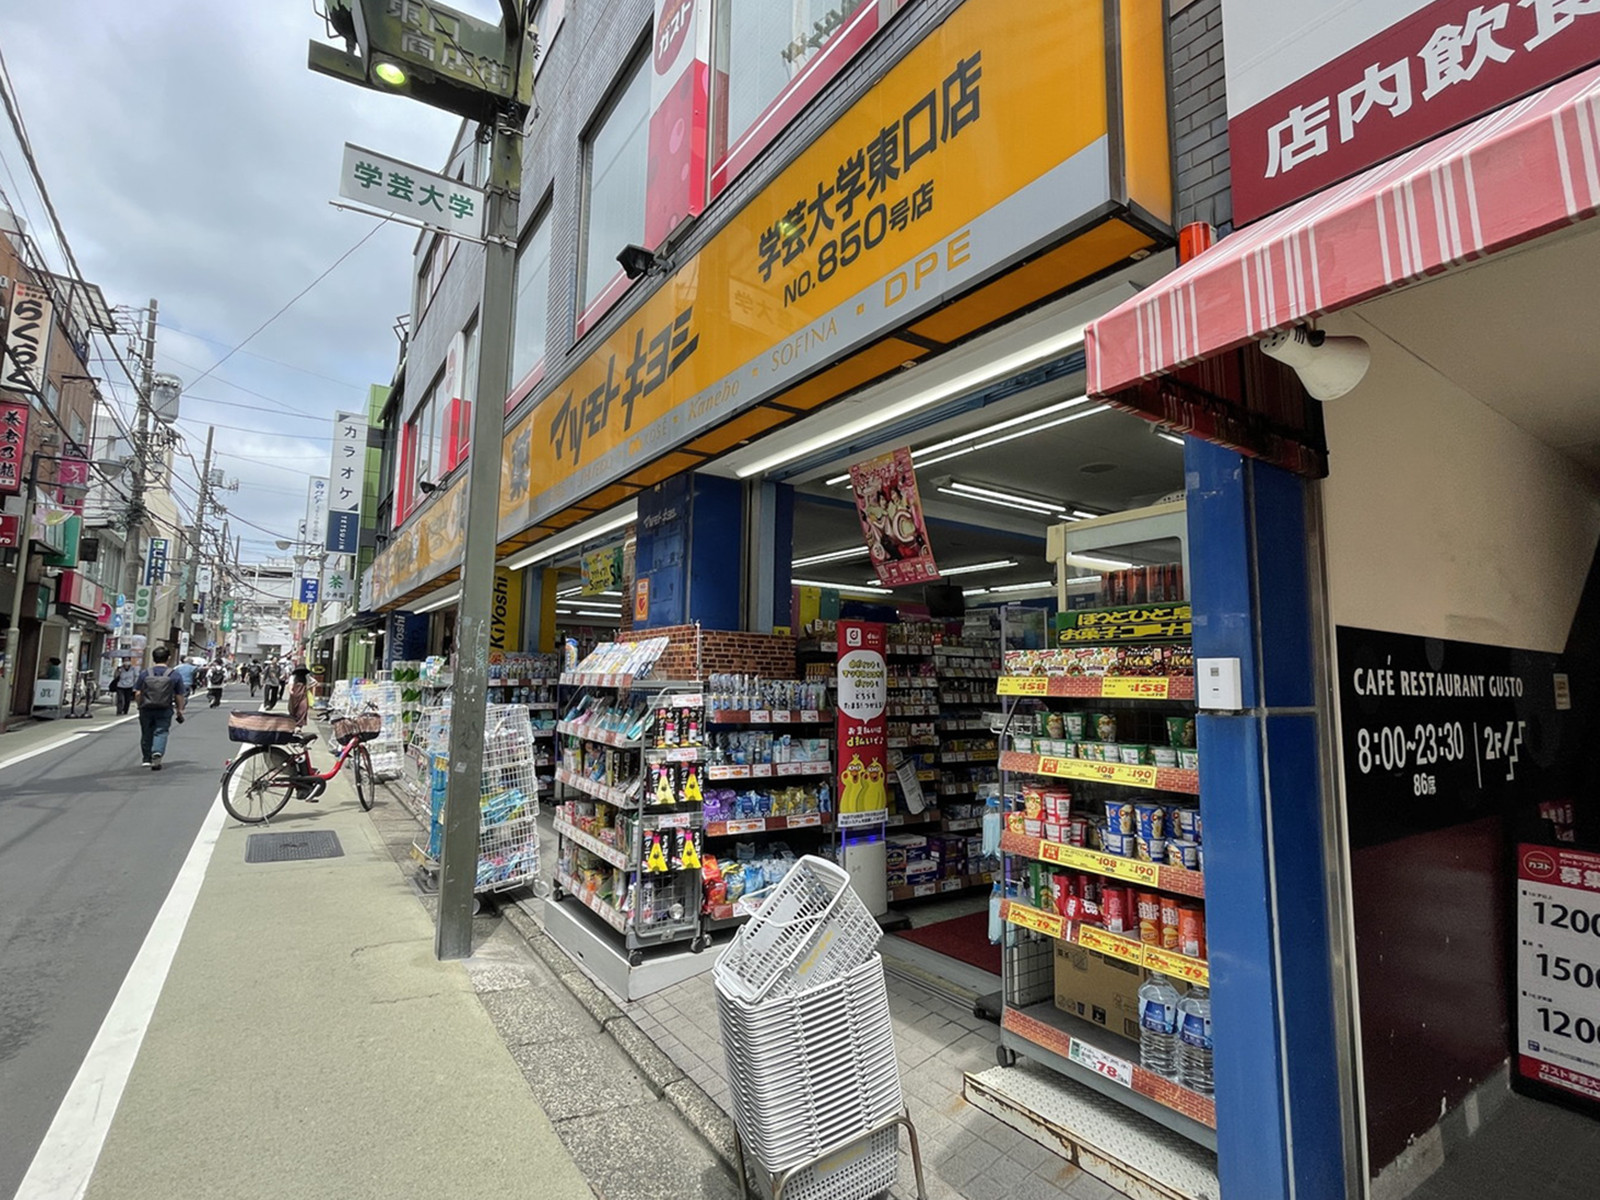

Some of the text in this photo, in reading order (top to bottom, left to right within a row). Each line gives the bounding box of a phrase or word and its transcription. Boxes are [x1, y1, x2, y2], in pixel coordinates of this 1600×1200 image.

[658, 1, 691, 60] ガスト
[402, 29, 511, 90] 商店街
[757, 49, 982, 283] 学芸大学東口店
[353, 160, 474, 219] 学芸大学
[884, 229, 971, 308] DPE
[6, 300, 43, 387] らくらく
[550, 305, 699, 466] マツモトキヨシ
[688, 379, 740, 422] Kanebo
[771, 316, 838, 372] SOFINA
[339, 425, 357, 500] カラオケ
[329, 574, 344, 589] 茶
[490, 576, 508, 649] KiYoshi
[1133, 683, 1167, 693] 158
[1353, 654, 1395, 696] CAFÉ
[1400, 670, 1485, 697] RESTAURANT
[1488, 675, 1524, 697] GUSTO
[1132, 769, 1152, 779] 190
[1099, 857, 1154, 876] 108 190
[1528, 861, 1551, 871] ガスト
[1036, 918, 1050, 929] 79
[1113, 944, 1129, 955] 79
[1183, 966, 1203, 979] 79
[1536, 953, 1600, 990] 150
[1537, 1007, 1600, 1044] 120
[1096, 1060, 1118, 1078] 78
